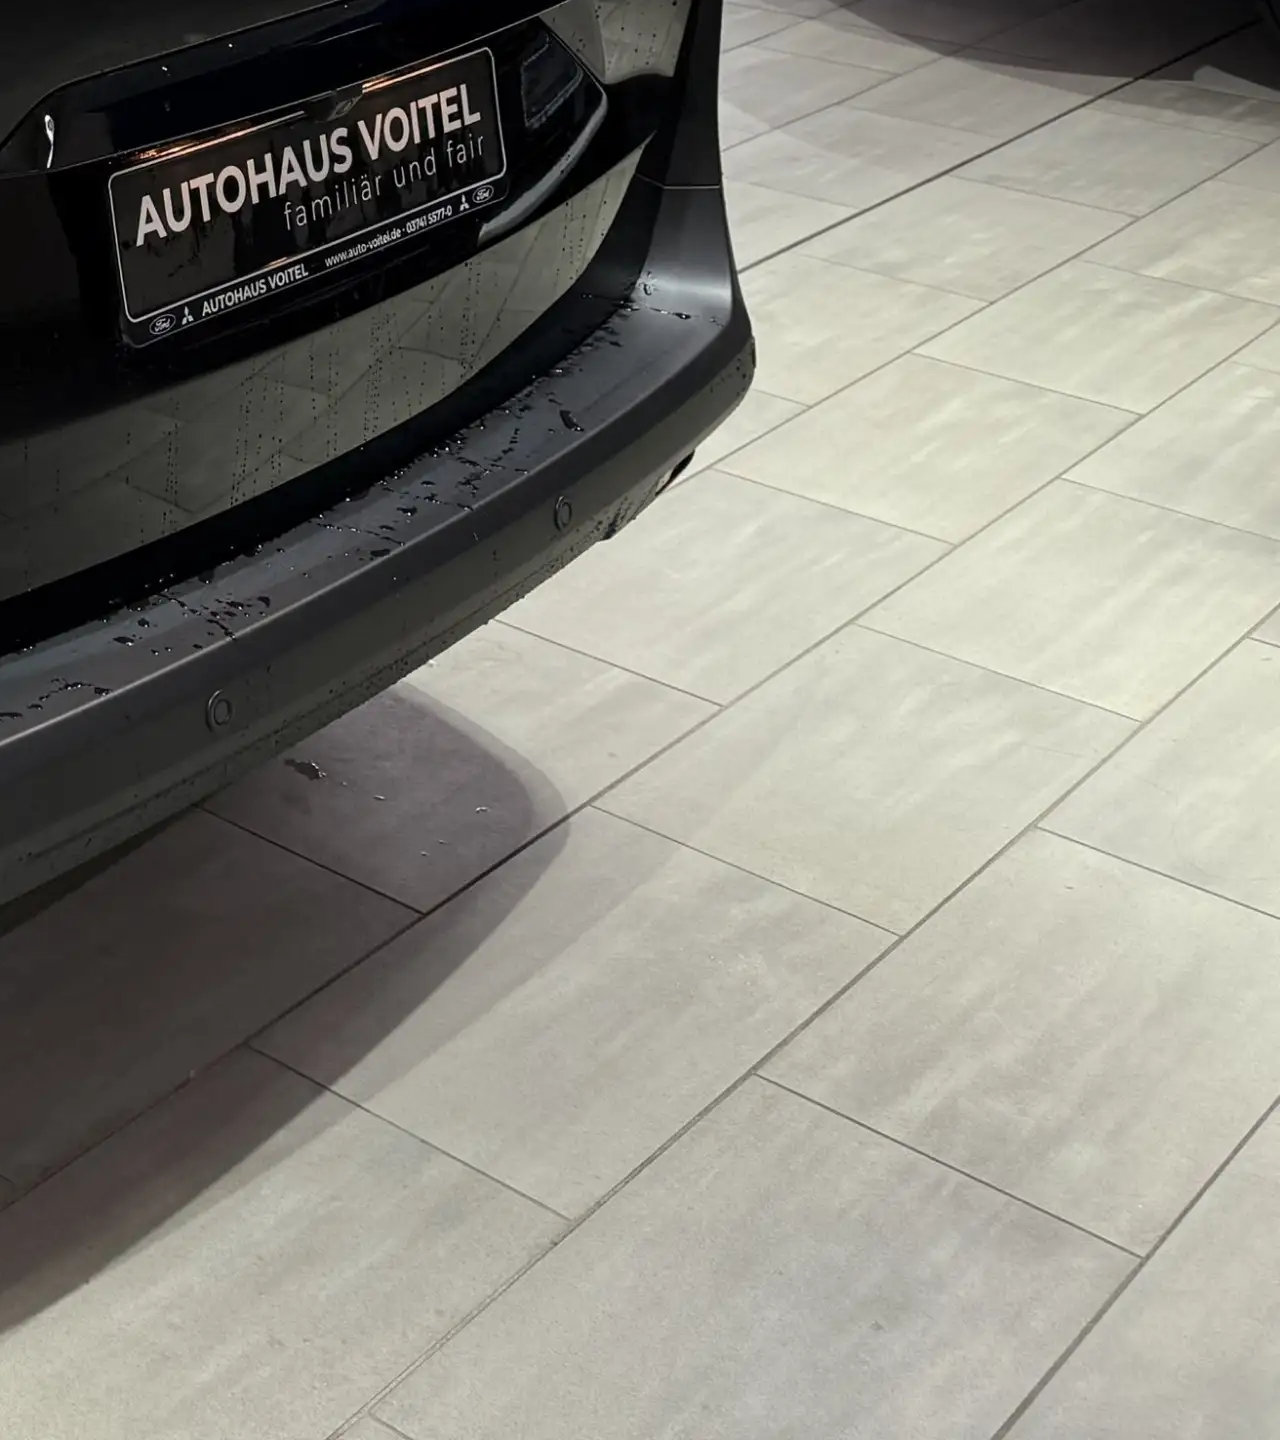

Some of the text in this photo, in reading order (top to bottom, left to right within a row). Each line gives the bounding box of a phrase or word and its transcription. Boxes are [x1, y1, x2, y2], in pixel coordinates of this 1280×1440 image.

[135, 83, 482, 247] AUTOHAUS VOITEL
[283, 133, 485, 231] familiär und fair
[201, 279, 267, 317] AUTOHAUS
[267, 264, 309, 290] VOITEL
[324, 228, 402, 267] www.auto-voitel.de
[406, 215, 428, 234] 03741
[427, 205, 453, 225] 5577-0
